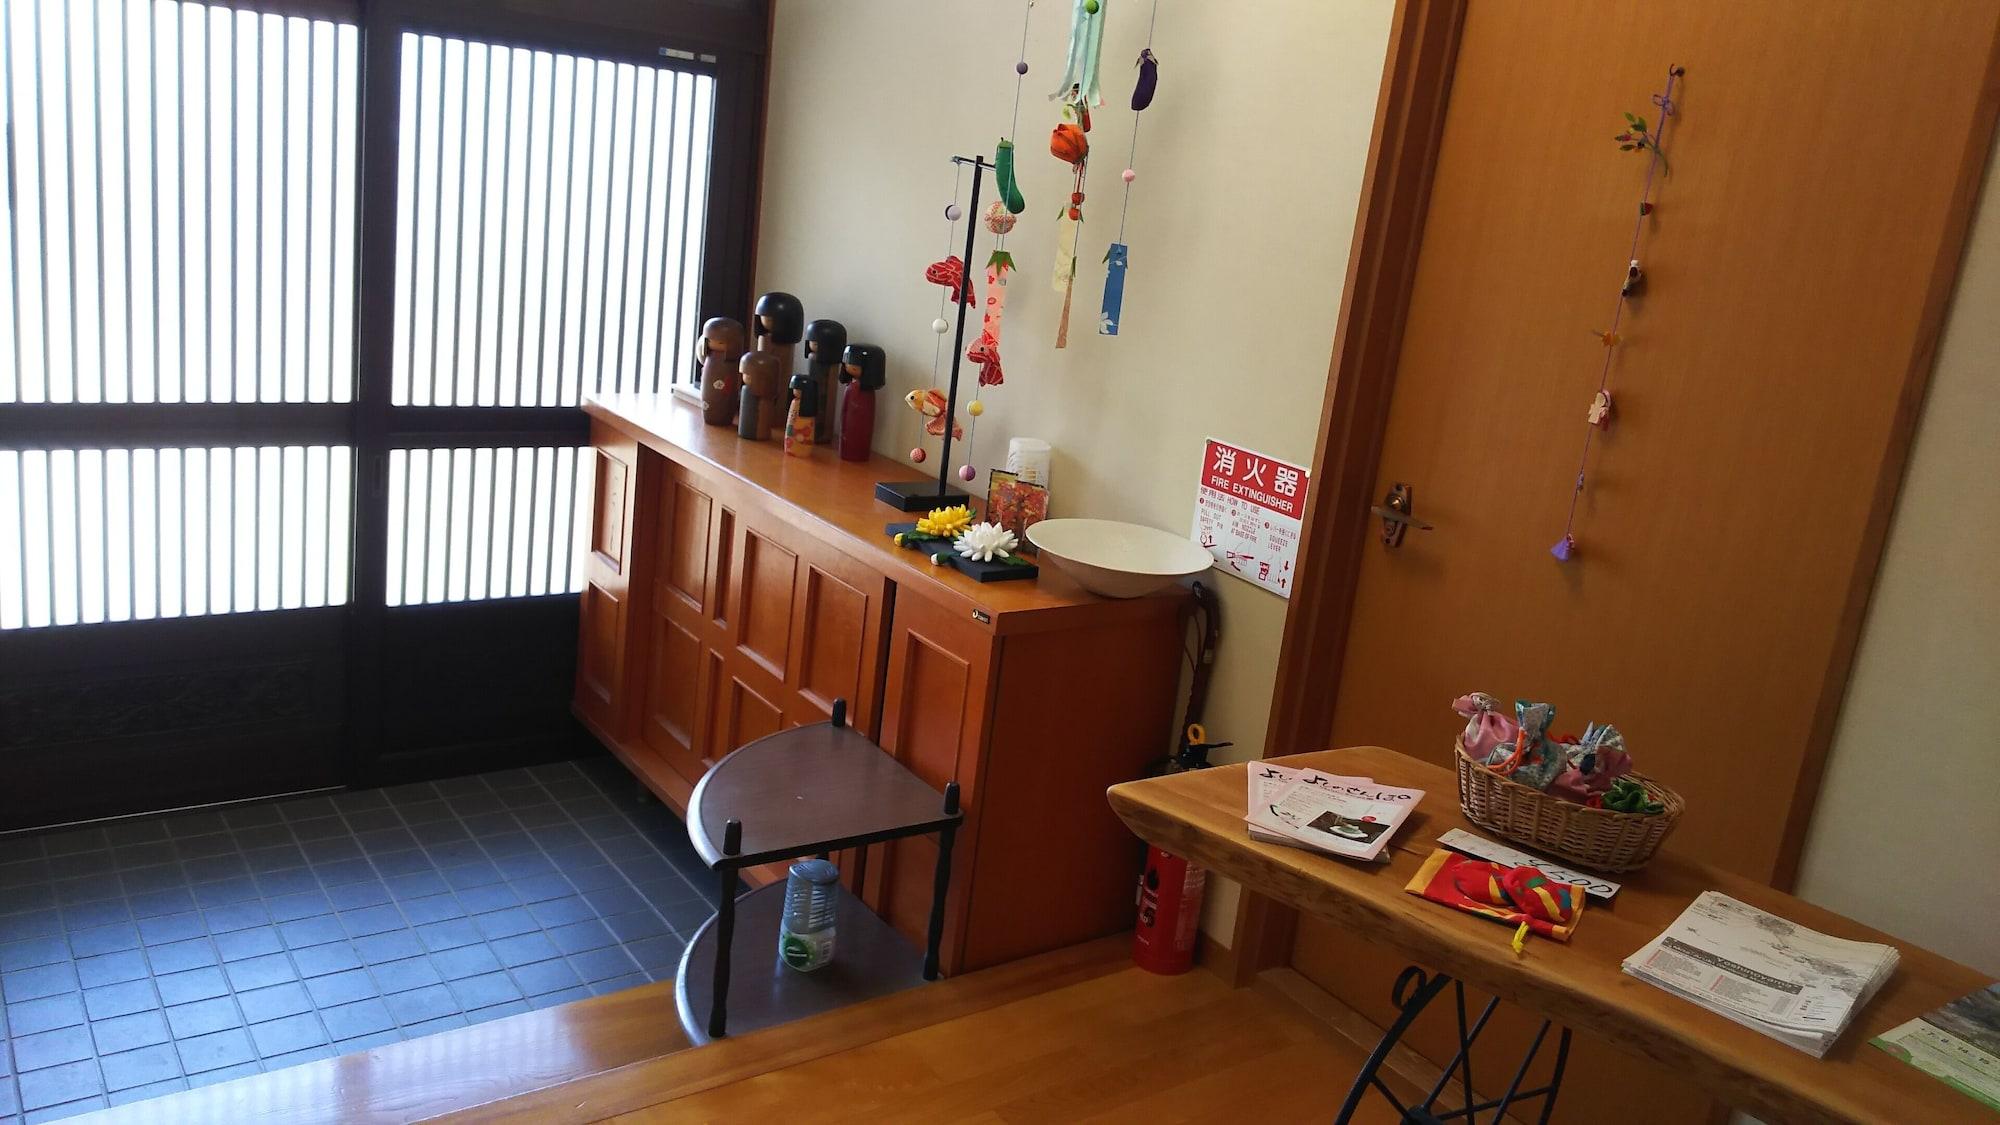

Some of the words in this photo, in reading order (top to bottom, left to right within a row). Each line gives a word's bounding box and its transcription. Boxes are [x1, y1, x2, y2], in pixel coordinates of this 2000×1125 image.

[1213, 446, 1298, 496] 消火器
[1211, 476, 1229, 490] FIRE
[1232, 483, 1293, 512] EXTINGUISHER
[1226, 497, 1238, 506] HOW
[1240, 501, 1247, 510] TO
[1250, 504, 1260, 514] USE
